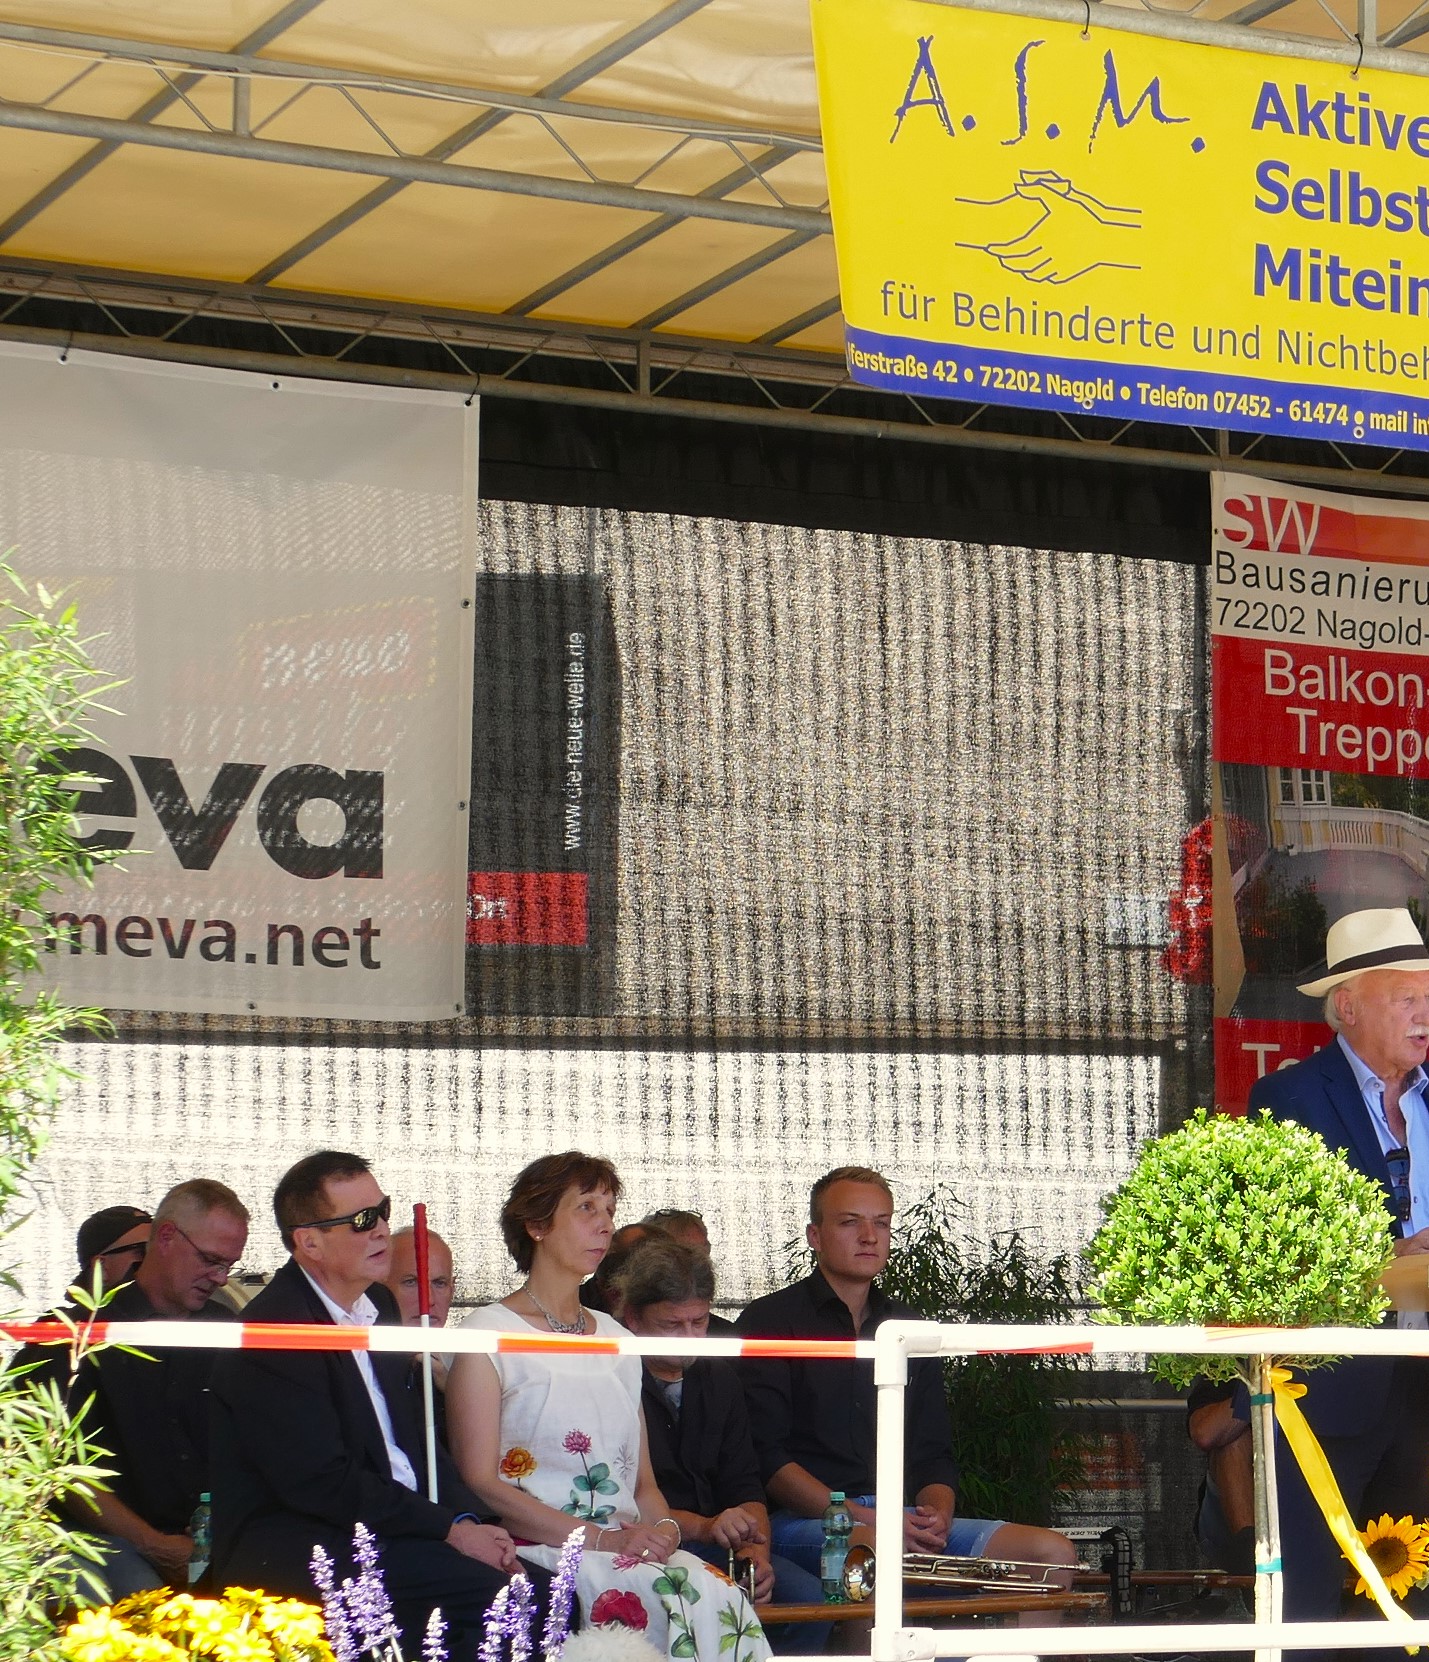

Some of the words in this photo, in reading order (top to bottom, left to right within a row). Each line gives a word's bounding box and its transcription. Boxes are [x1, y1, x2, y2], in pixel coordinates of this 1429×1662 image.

[881, 280, 935, 322] für
[953, 291, 1175, 350] Behinderte
[1192, 324, 1261, 361] und
[932, 360, 958, 383] 42
[980, 365, 1041, 393] 72202
[1046, 374, 1114, 403] Nagold
[1137, 383, 1209, 411] Telefon
[1213, 391, 1271, 418] 07452
[1289, 400, 1349, 426] 61474
[1370, 410, 1408, 433] mail
[1221, 493, 1322, 556] SW
[1215, 598, 1307, 635] 72202
